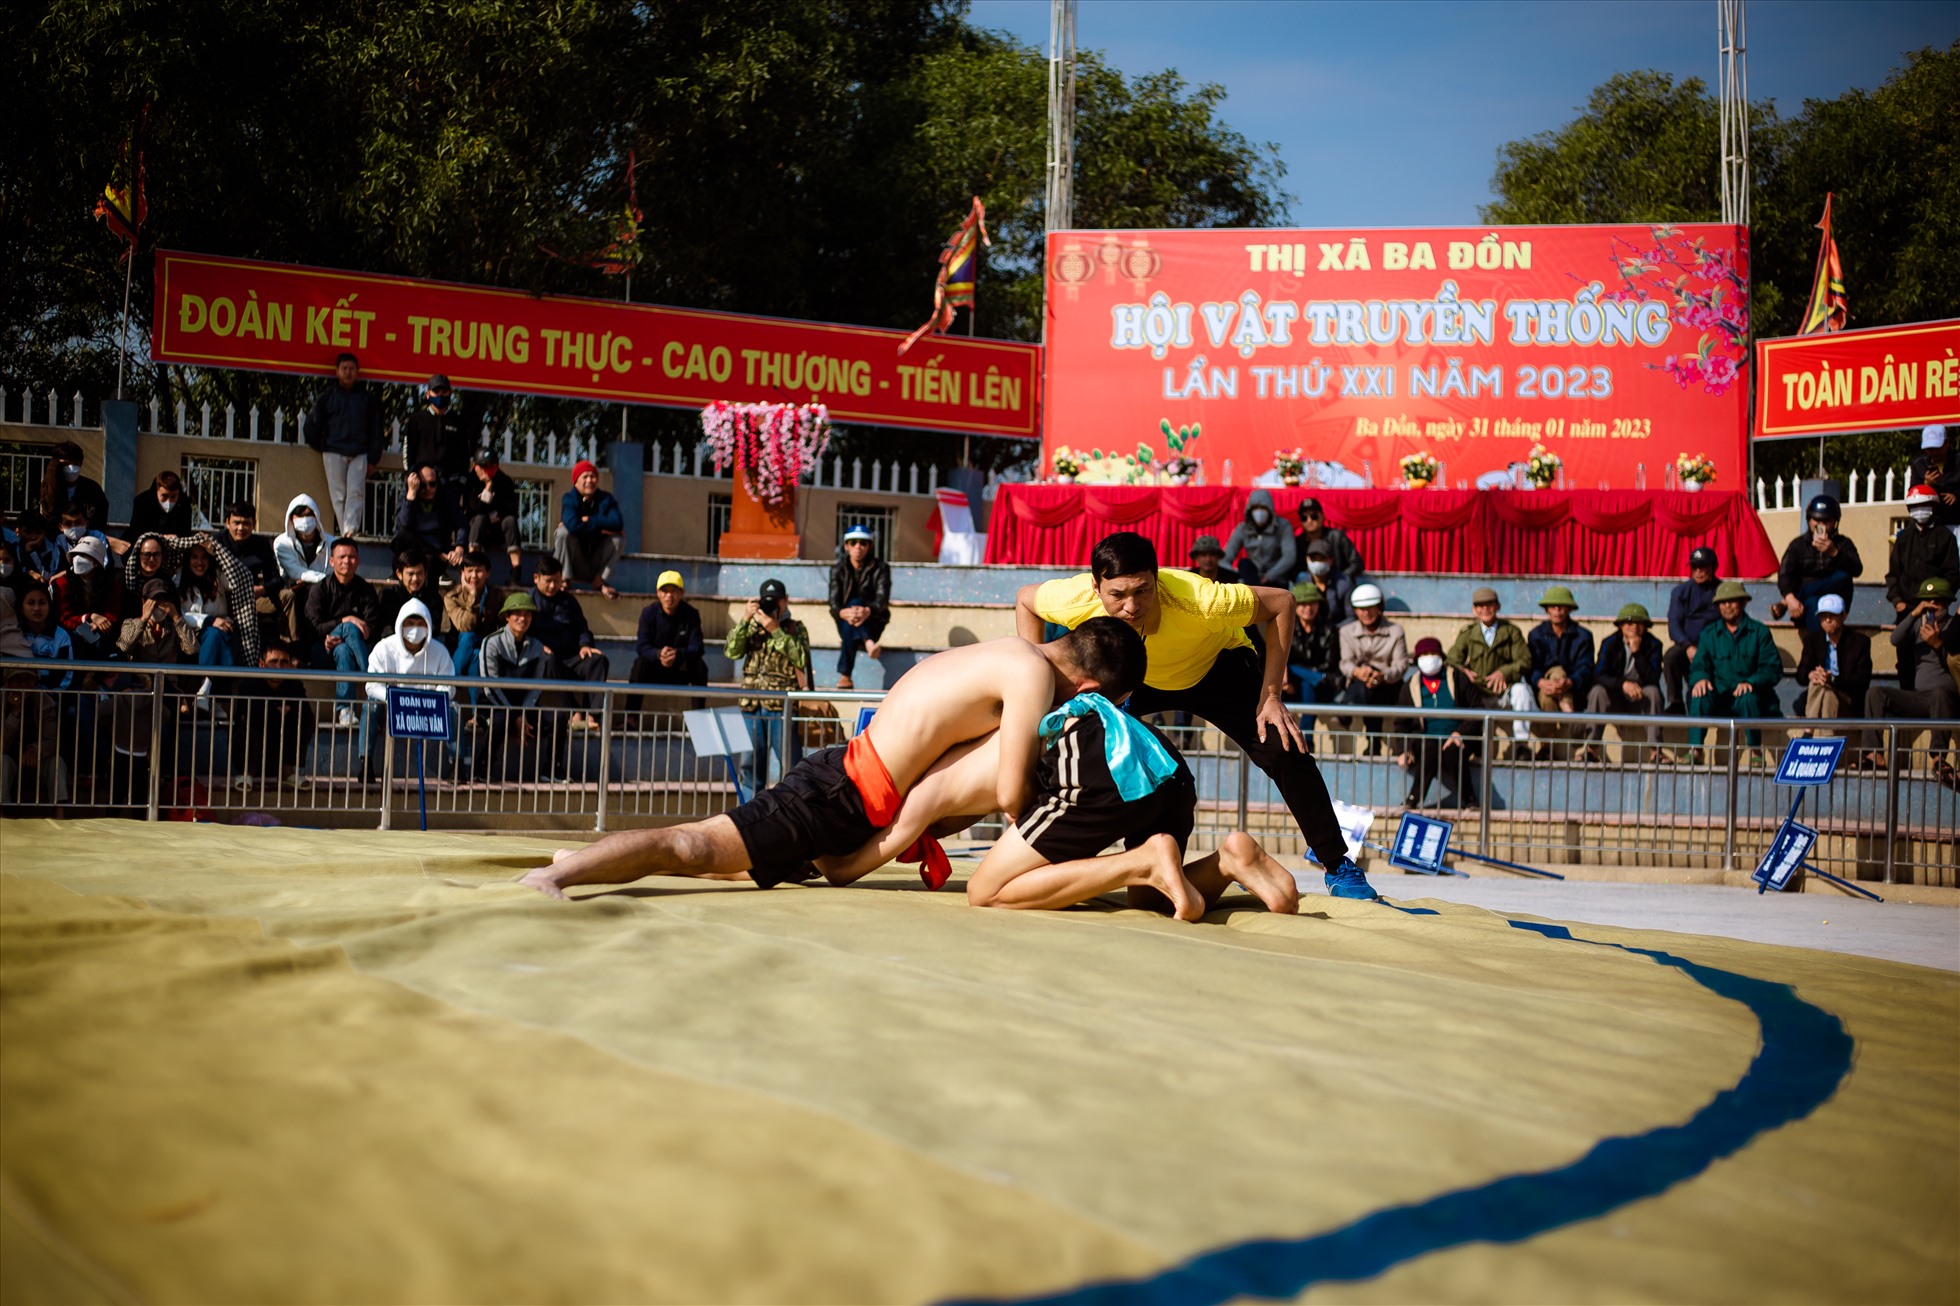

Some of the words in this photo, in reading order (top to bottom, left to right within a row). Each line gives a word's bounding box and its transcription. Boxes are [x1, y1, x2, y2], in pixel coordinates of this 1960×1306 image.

[1245, 244, 1306, 277] THỊ
[1318, 238, 1371, 271] XÃ
[1383, 242, 1437, 270] BA
[1448, 232, 1532, 270] ĐỒN
[1111, 291, 1194, 358] HỘI
[1200, 289, 1298, 357] VẬT
[1304, 280, 1496, 347] TRUYỀN
[1506, 281, 1671, 347] THỐNG
[179, 290, 293, 342] ĐOÀN
[305, 293, 376, 349] KẾT
[408, 315, 530, 364] TRUNG
[540, 330, 632, 383] THỰC
[662, 341, 732, 383] CAO
[741, 349, 871, 402] THƯỢNG
[897, 354, 960, 403] TIẾN
[969, 365, 1021, 410] LÊN
[1163, 356, 1238, 399] LẦN
[1250, 358, 1330, 398] THỨ
[1340, 364, 1395, 398] XXI
[1409, 358, 1502, 398] NĂM
[1515, 364, 1612, 398] 2023
[1782, 360, 1853, 411] TOÀN
[1860, 354, 1918, 405] DÂN
[1355, 417, 1379, 437] Ba
[1382, 413, 1422, 439] Đồn,
[1425, 417, 1467, 441] ngày
[1468, 417, 1489, 437] 31
[1493, 417, 1542, 442] tháng
[1544, 418, 1565, 438] 01
[1569, 418, 1608, 438] năm
[1610, 419, 1652, 438] 2023
[399, 695, 421, 708] ĐOÀN
[406, 710, 428, 733] QUẢNG
